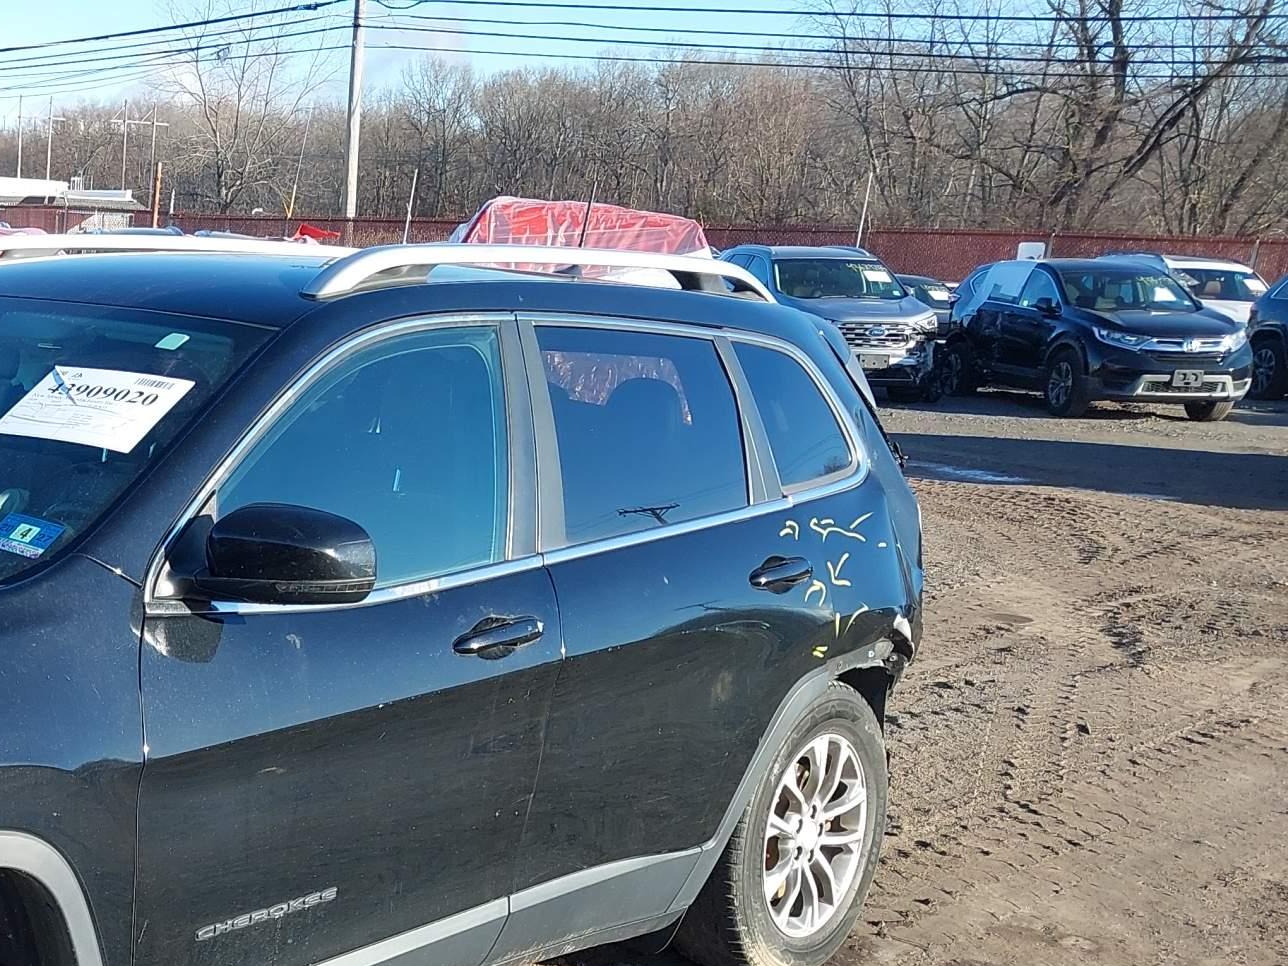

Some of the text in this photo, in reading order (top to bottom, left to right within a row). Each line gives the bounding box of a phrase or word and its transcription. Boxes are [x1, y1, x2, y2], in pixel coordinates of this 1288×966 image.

[48, 383, 159, 406] 43909020
[19, 527, 32, 539] 4
[195, 887, 338, 941] CHEROKEE
